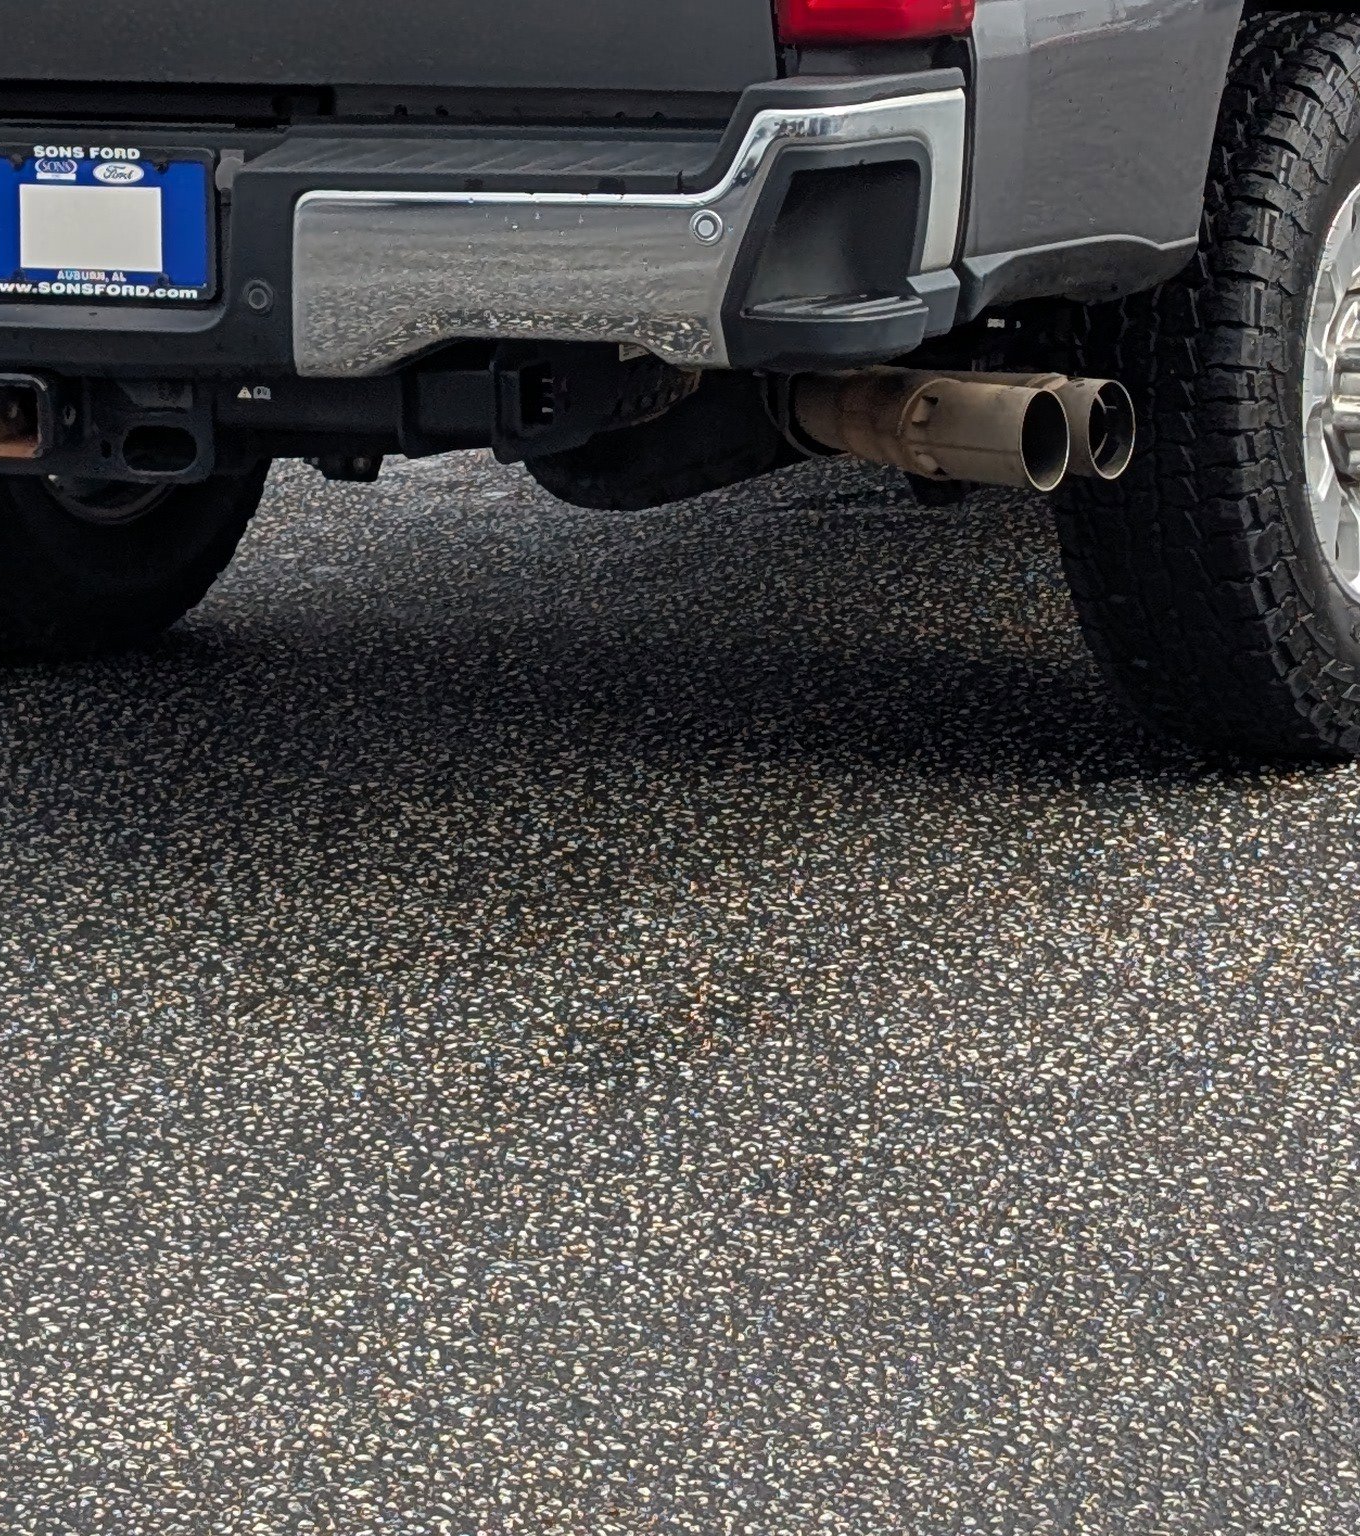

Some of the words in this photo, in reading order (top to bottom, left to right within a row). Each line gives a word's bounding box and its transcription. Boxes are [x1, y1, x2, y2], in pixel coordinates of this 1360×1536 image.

[33, 145, 84, 159] SONS
[89, 147, 140, 160] FORD
[111, 271, 127, 282] AL
